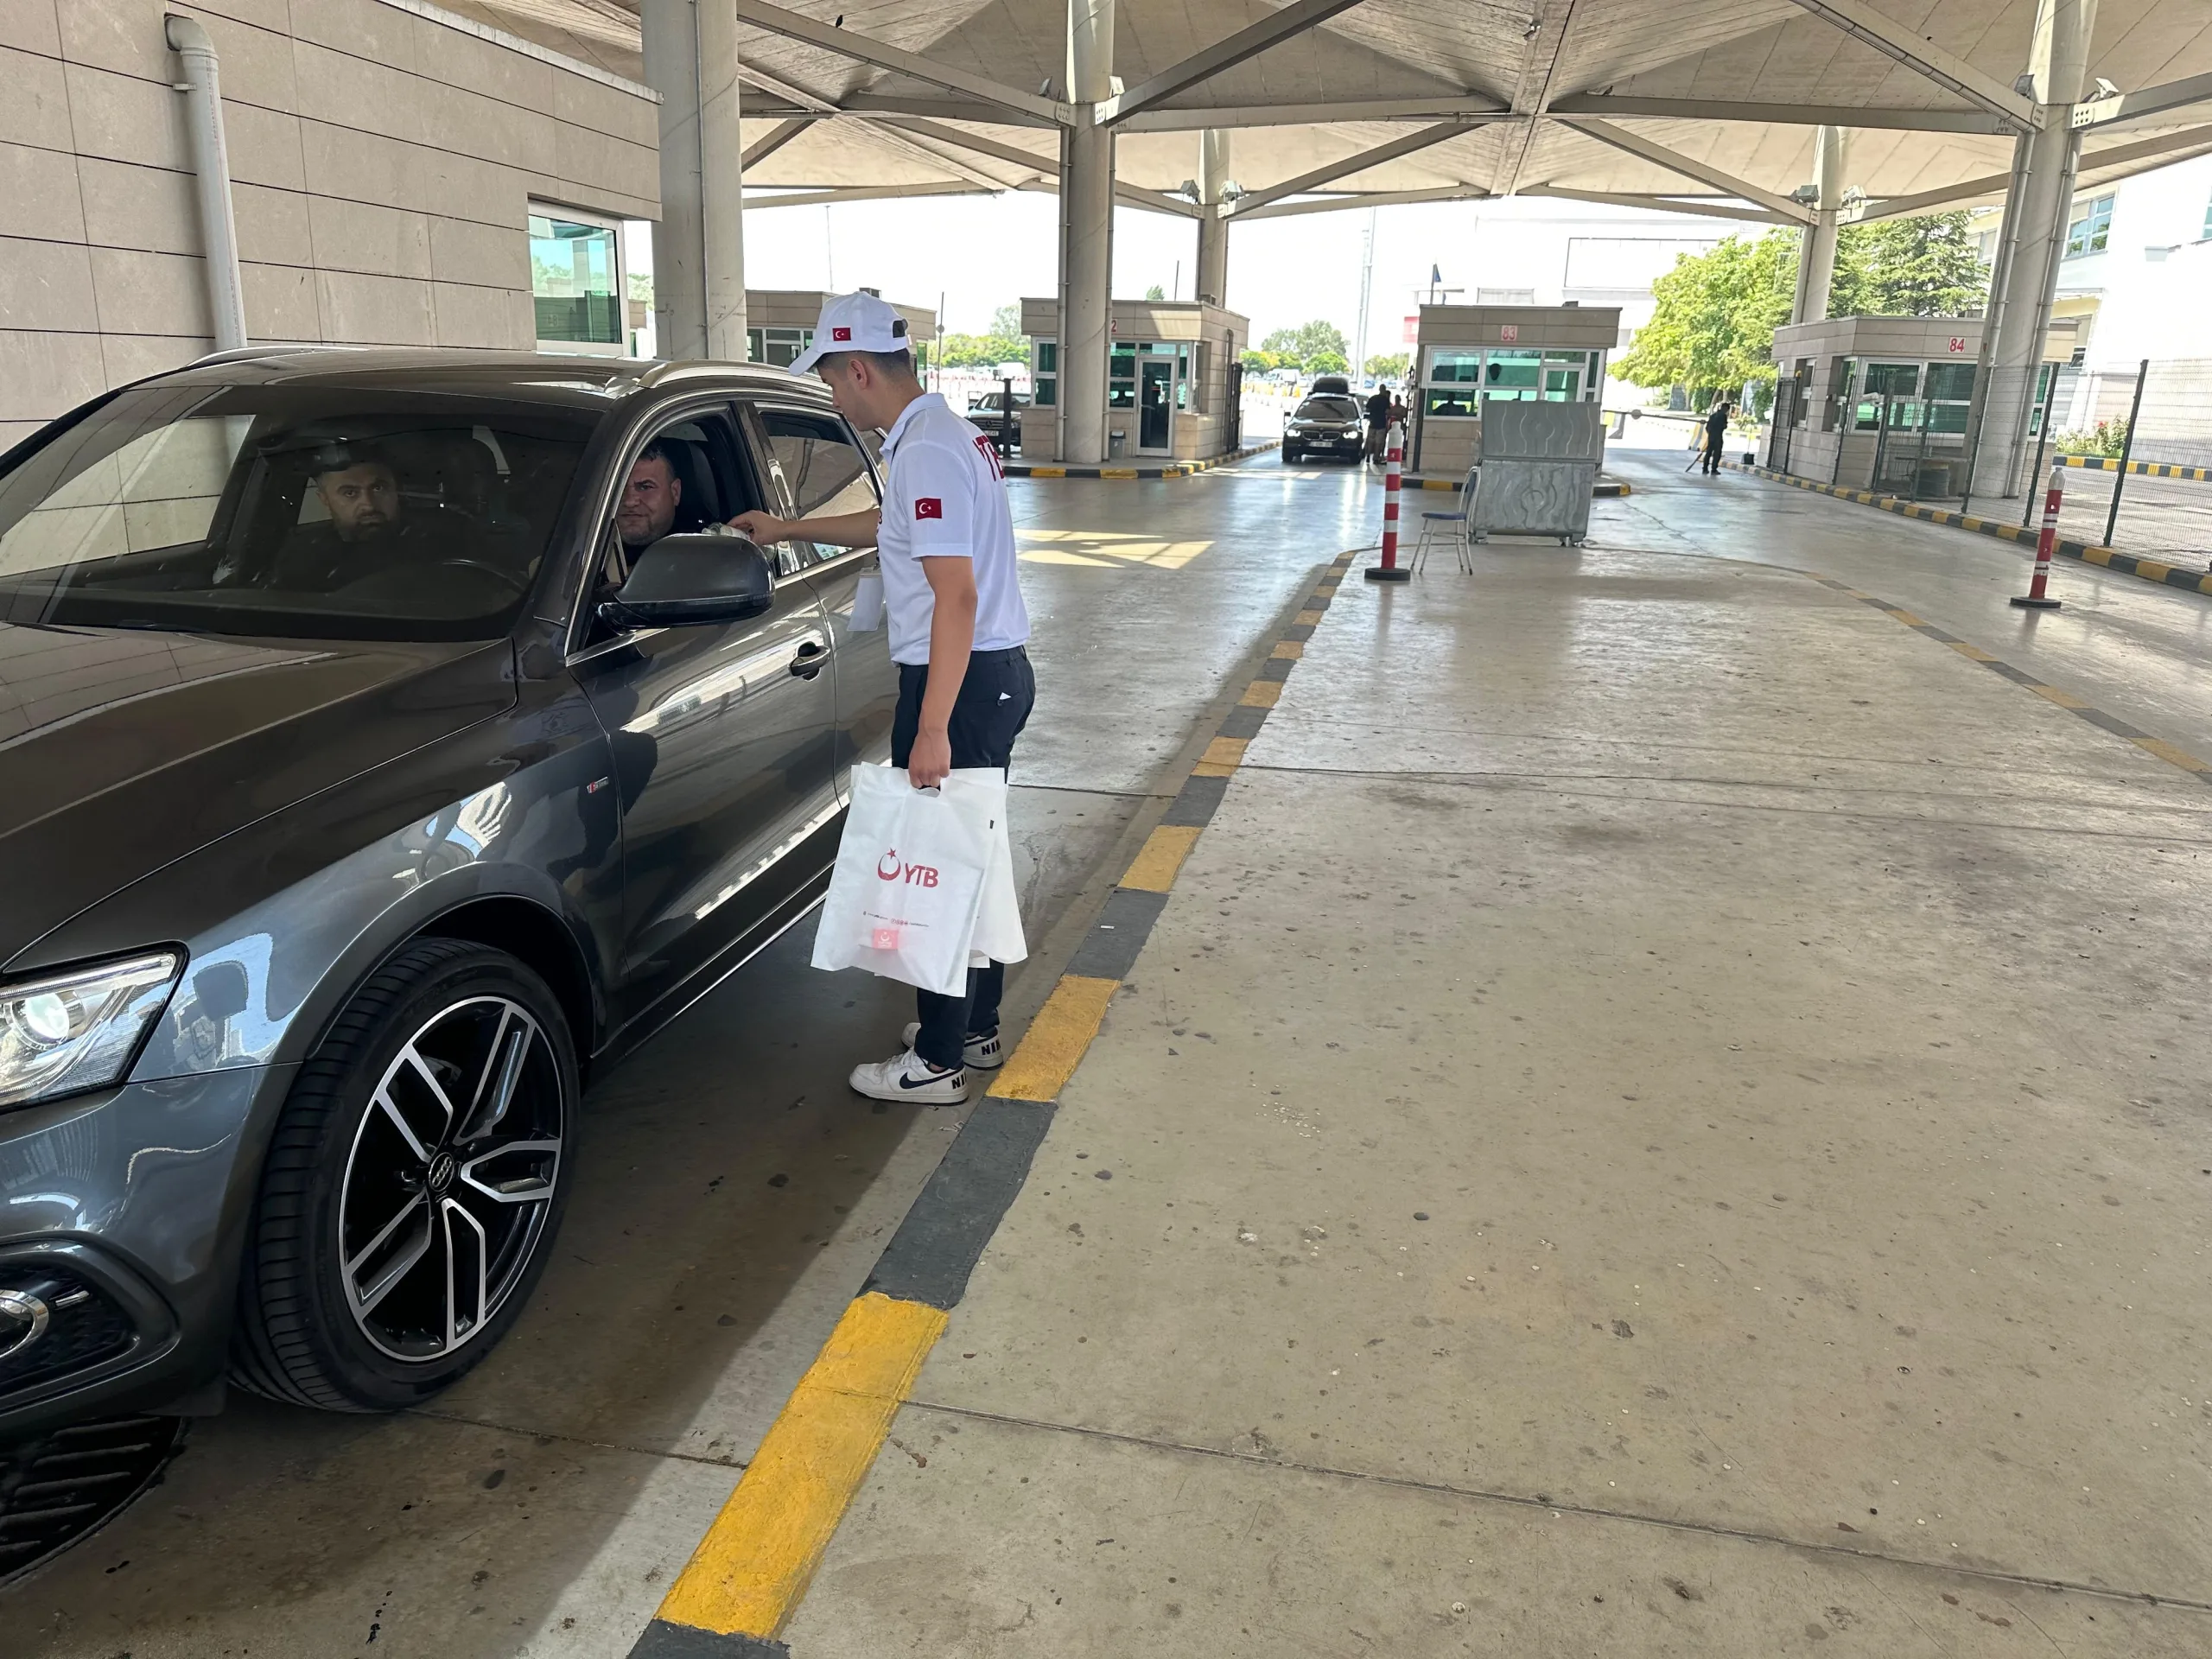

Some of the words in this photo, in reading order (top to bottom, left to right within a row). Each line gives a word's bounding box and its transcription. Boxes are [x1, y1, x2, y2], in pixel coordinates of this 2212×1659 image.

[1503, 327, 1516, 340] 83
[1949, 338, 1965, 352] 84
[905, 862, 938, 888] YTB
[951, 1072, 967, 1090] NI
